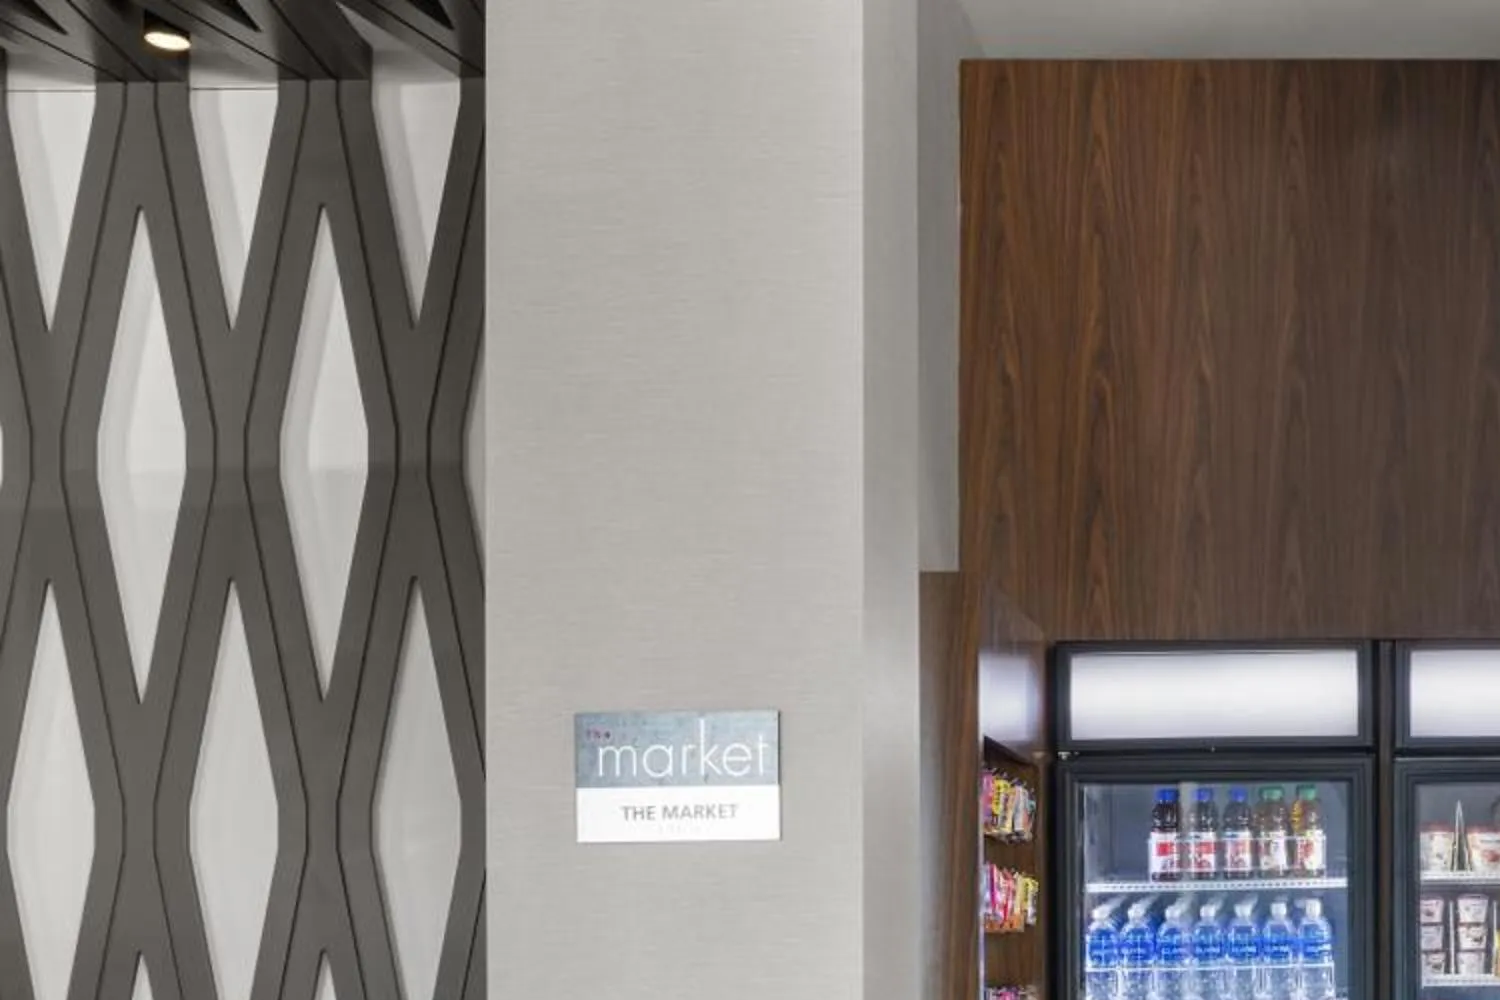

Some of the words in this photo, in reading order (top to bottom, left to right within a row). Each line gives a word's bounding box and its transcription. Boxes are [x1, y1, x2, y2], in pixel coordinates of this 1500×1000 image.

[597, 718, 769, 778] market
[620, 804, 657, 821] THE
[661, 803, 738, 820] MARKET
